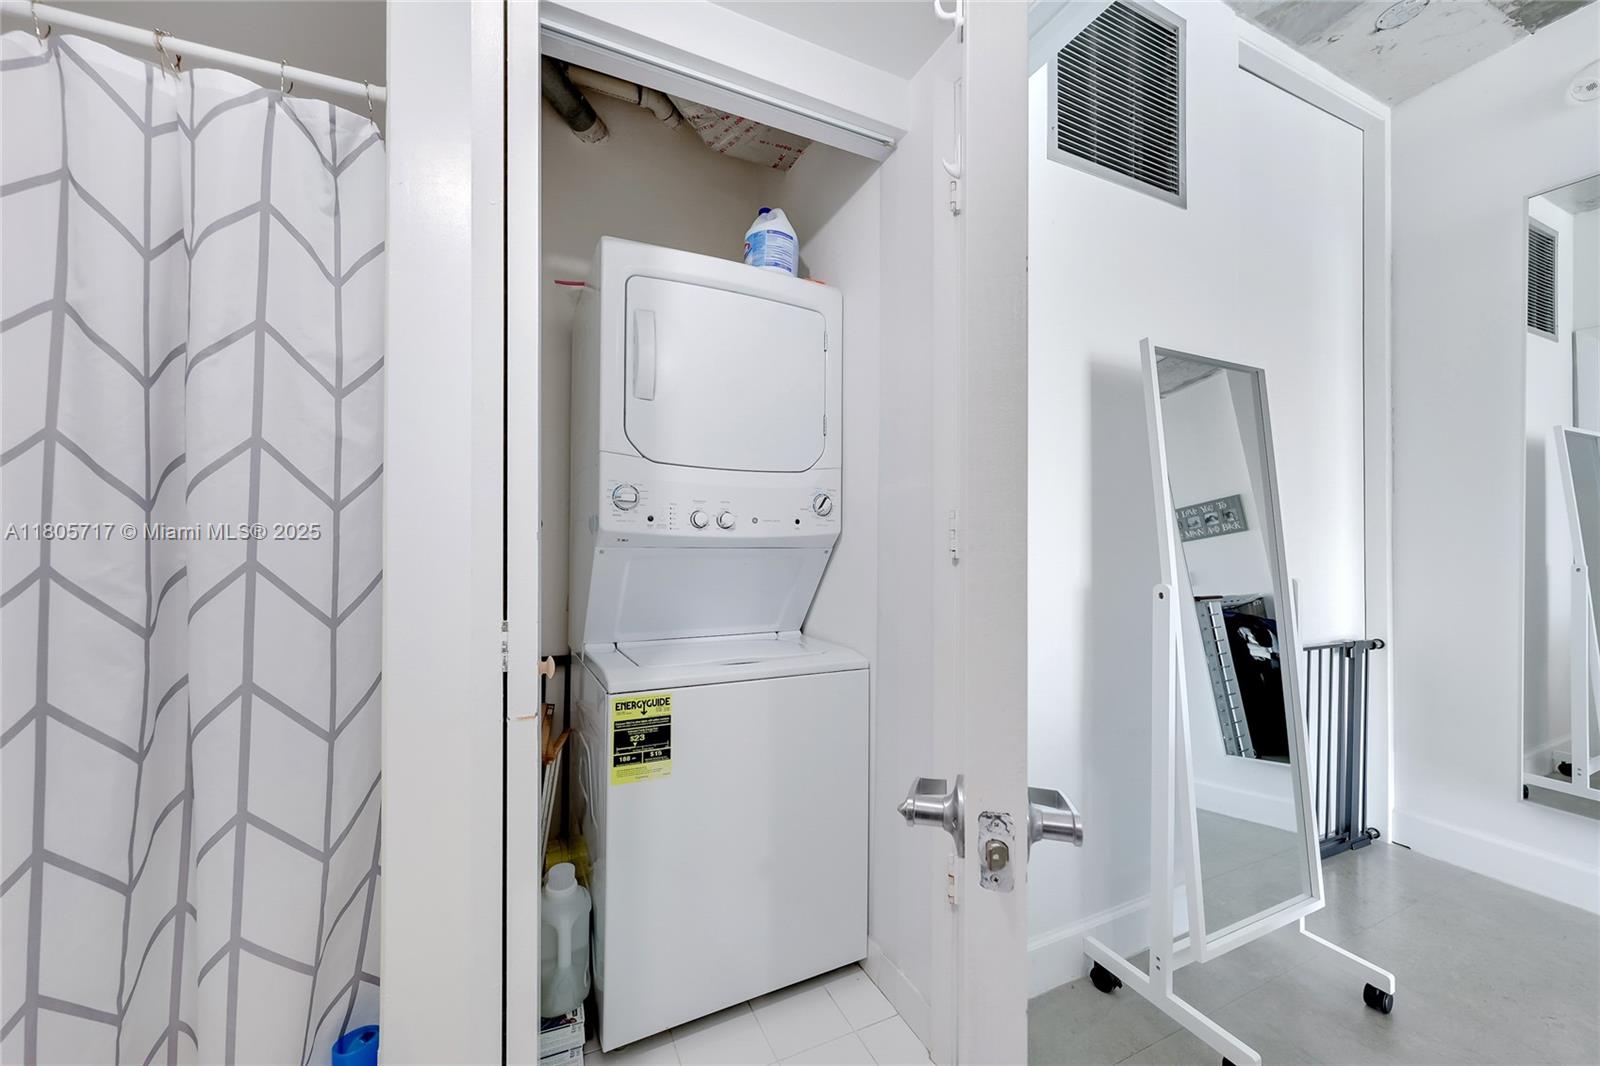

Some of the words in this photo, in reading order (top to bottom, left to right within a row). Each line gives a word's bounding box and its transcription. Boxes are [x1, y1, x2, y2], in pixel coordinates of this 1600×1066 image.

[1200, 504, 1214, 513] YOU
[1217, 501, 1227, 510] TO
[615, 697, 671, 711] ENERGYGUIDE
[630, 734, 645, 742] $23
